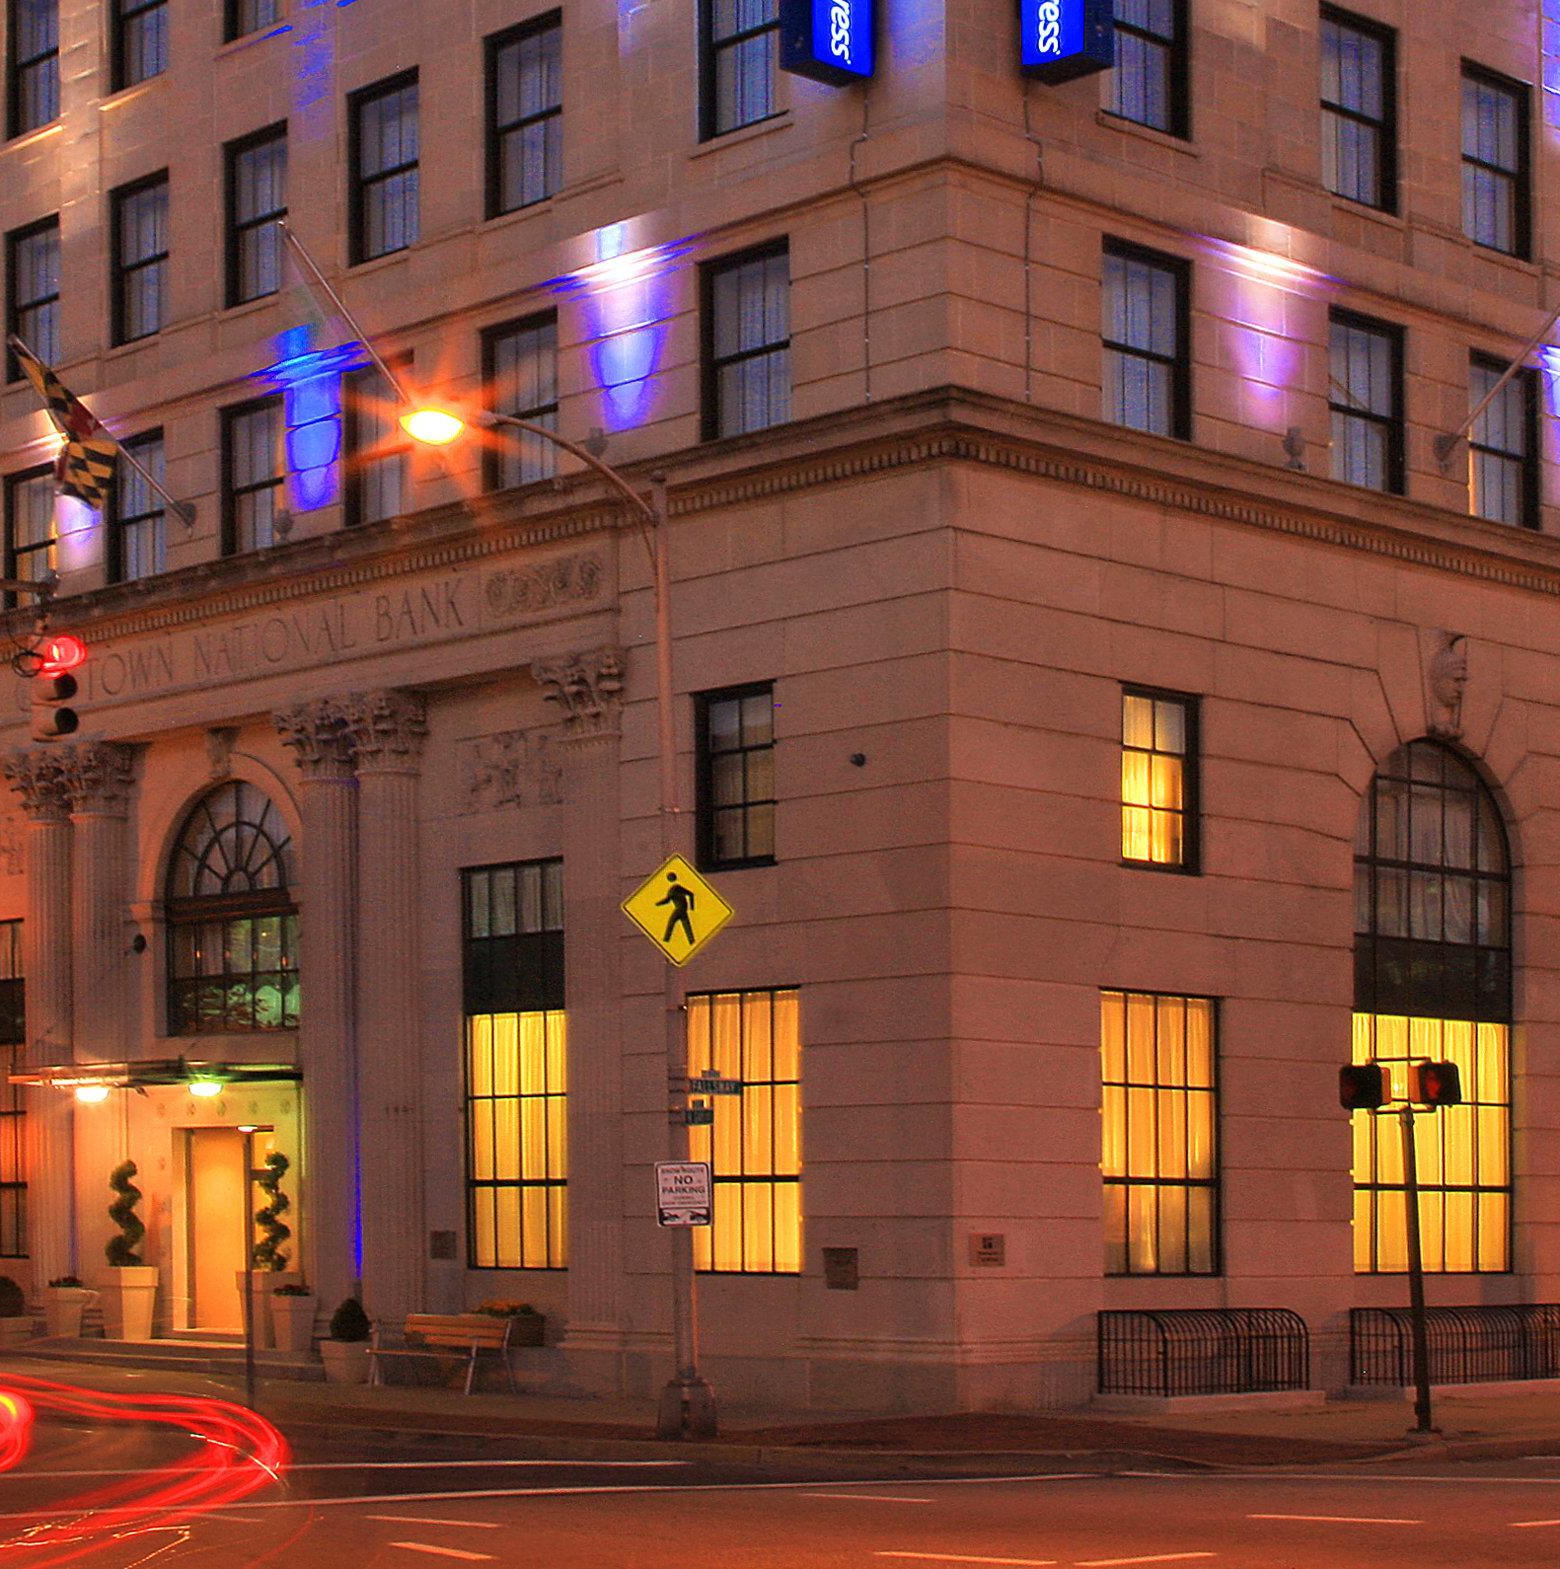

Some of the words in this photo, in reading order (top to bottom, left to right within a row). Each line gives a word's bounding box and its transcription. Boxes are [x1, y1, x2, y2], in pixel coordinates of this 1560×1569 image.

[86, 641, 175, 700] TOWN
[193, 602, 357, 680] NATIONAL
[374, 577, 466, 643] BANK
[673, 1175, 694, 1184] NO
[662, 1186, 705, 1194] PARKING
